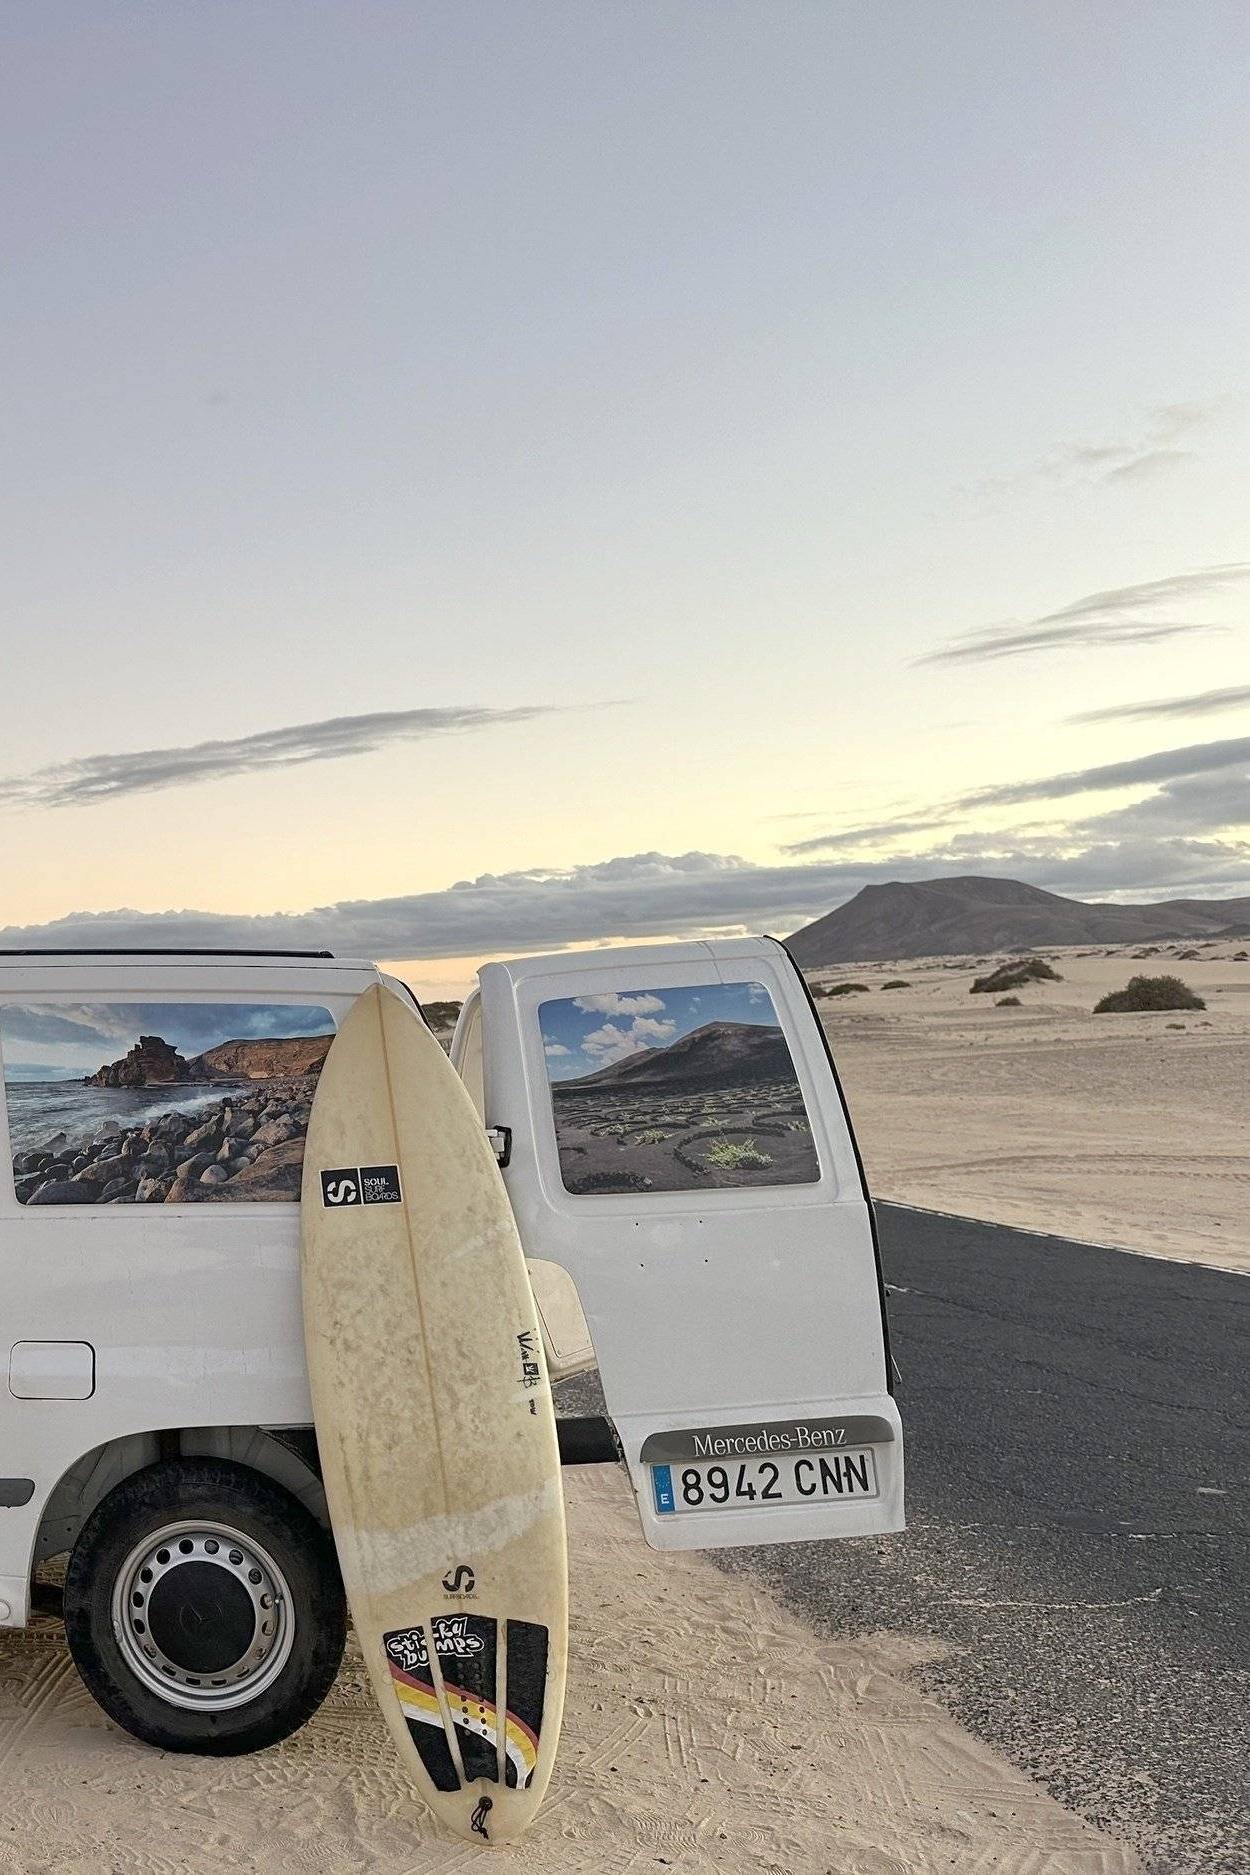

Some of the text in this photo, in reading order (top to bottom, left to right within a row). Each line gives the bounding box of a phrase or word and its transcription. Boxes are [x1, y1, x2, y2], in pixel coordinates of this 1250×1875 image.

[363, 1177, 389, 1187] SOUL
[365, 1191, 399, 1201] BOARDS
[693, 1427, 847, 1457] Mercedes-Benz
[681, 1455, 869, 1505] 8942 CNN
[661, 1494, 670, 1504] E
